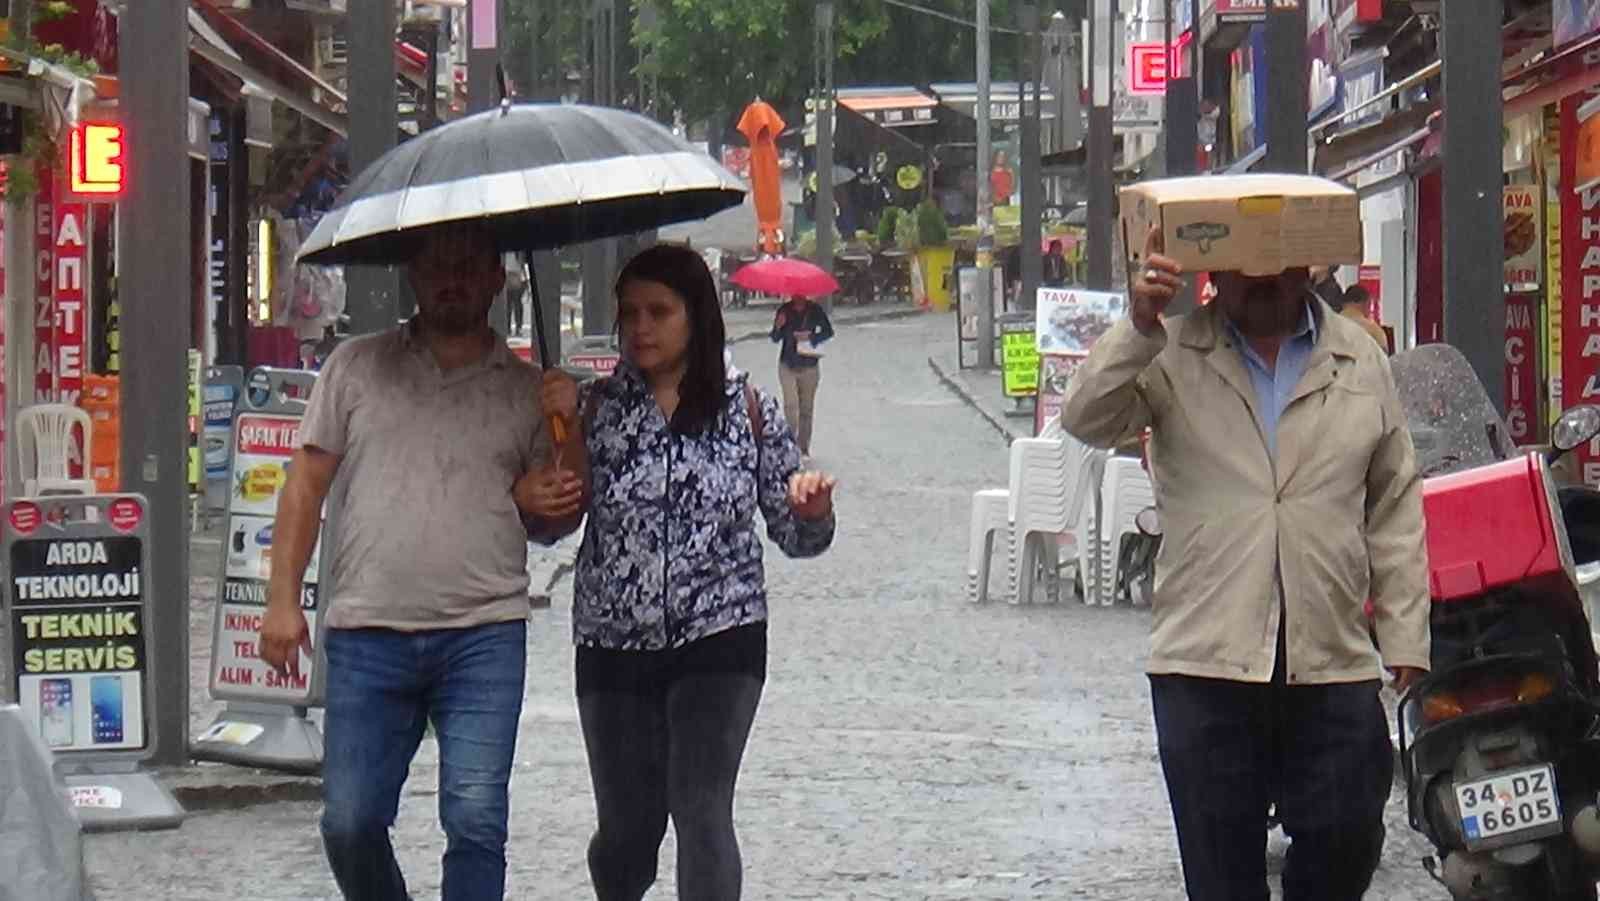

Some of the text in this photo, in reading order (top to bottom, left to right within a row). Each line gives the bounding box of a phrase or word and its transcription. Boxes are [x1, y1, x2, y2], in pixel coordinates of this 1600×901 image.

[1043, 291, 1077, 304] TAVA
[46, 541, 108, 566] ARDA
[14, 567, 140, 600] TEKNOLOJİ
[21, 607, 137, 639] TEKNİK
[24, 641, 136, 672] SERVİS
[1462, 772, 1548, 808] 34 DZ
[1482, 799, 1551, 831] 6605
